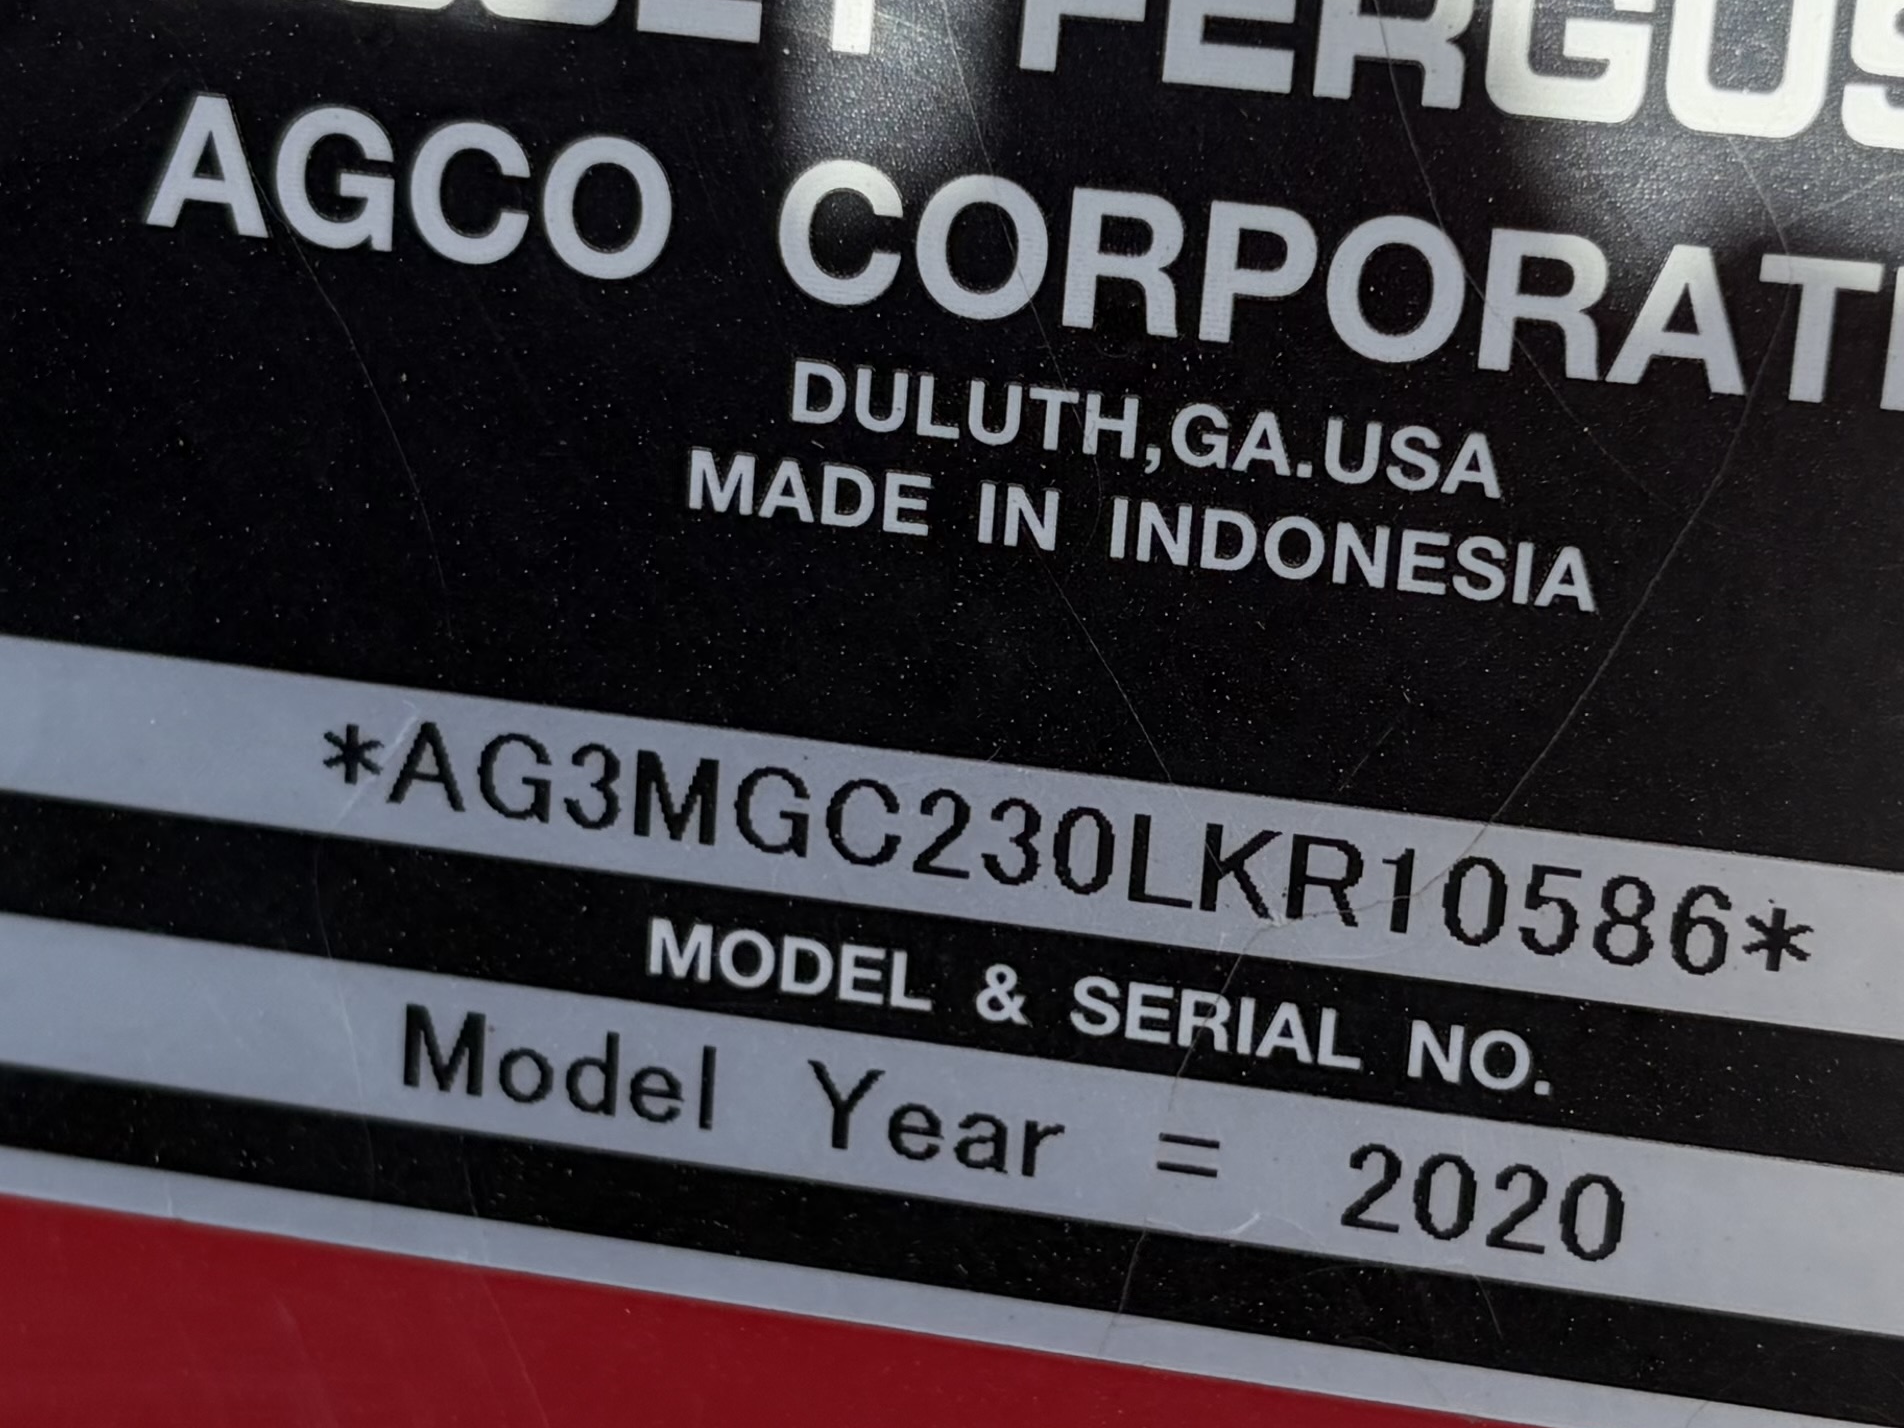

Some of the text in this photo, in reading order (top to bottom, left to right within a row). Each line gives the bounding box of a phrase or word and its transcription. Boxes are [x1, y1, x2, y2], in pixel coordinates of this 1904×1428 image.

[144, 93, 673, 281] AGCO
[791, 359, 1501, 500] DULUTH,GA.USA
[687, 448, 1597, 613] MADE IN INDONESIA
[646, 917, 1553, 1097] MODEL & SERIAL NO.
[403, 1003, 1627, 1263] Model Year = 2020
